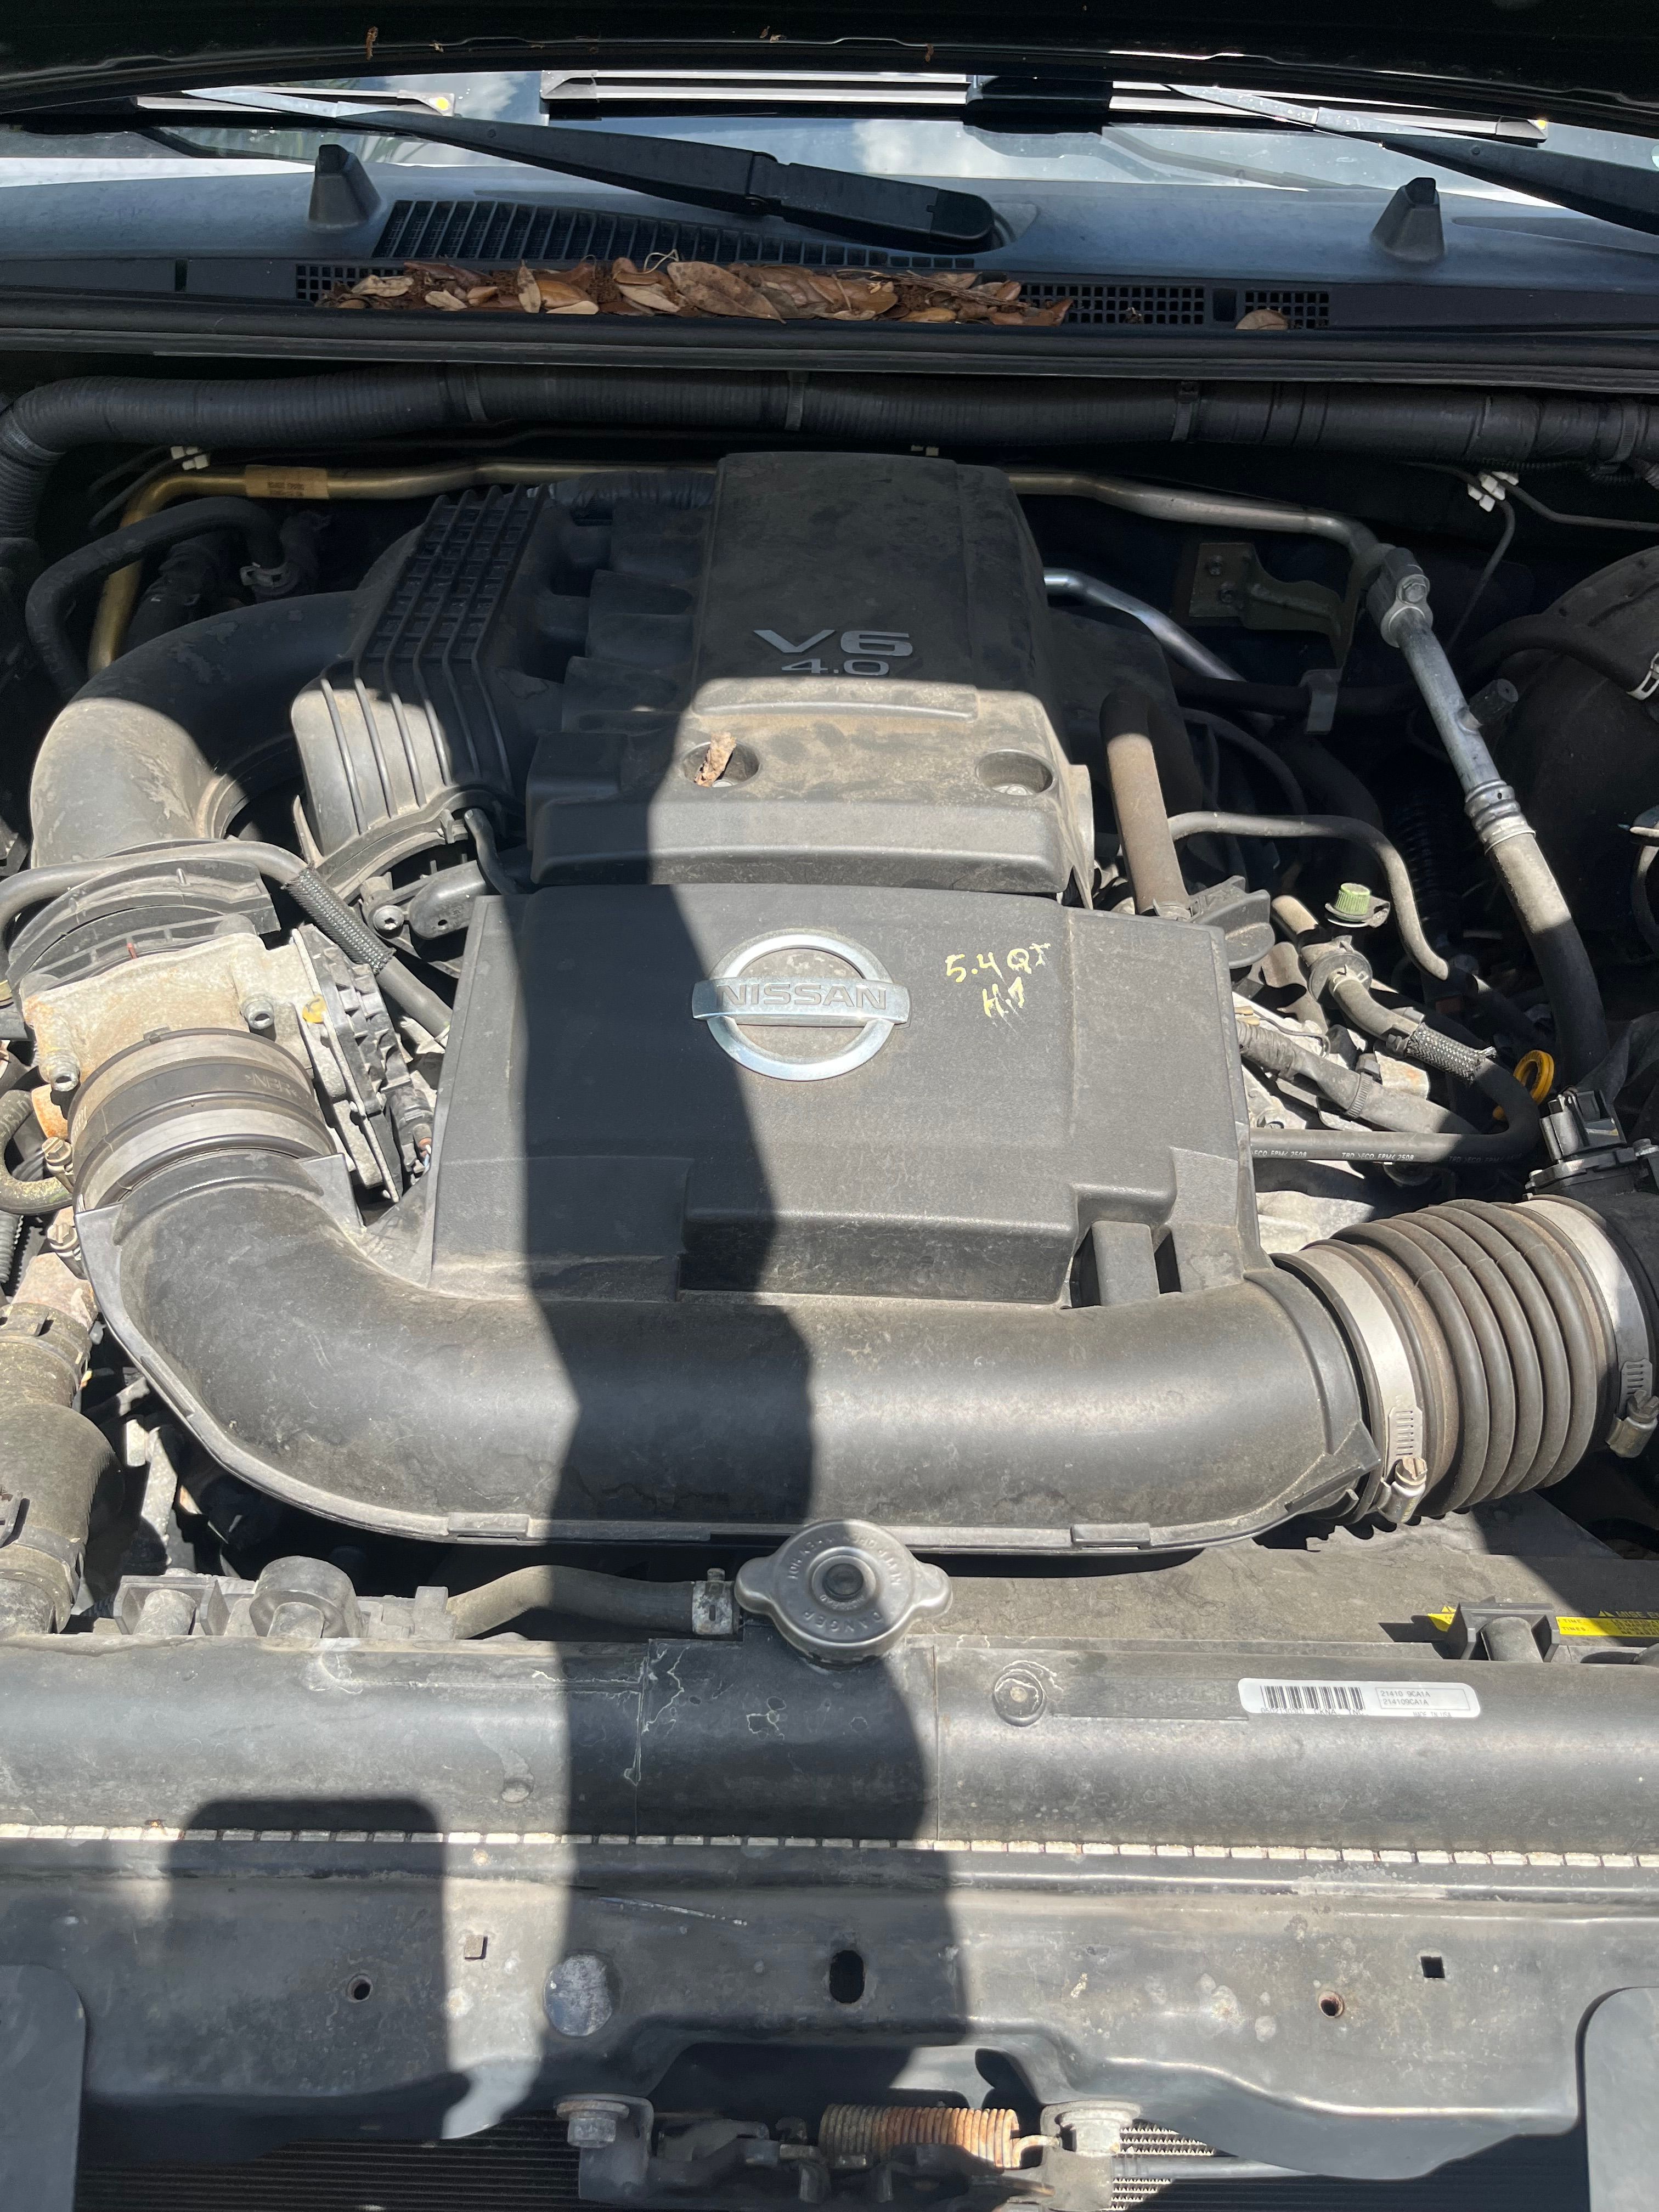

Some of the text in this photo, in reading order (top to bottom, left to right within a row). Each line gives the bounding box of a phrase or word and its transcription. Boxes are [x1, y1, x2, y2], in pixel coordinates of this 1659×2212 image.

[753, 630, 913, 656] V6
[781, 659, 889, 676] 4.0
[945, 943, 1051, 983] 5.4 QT
[716, 983, 887, 1010] NISSAN
[803, 1611, 882, 1633] DANGER
